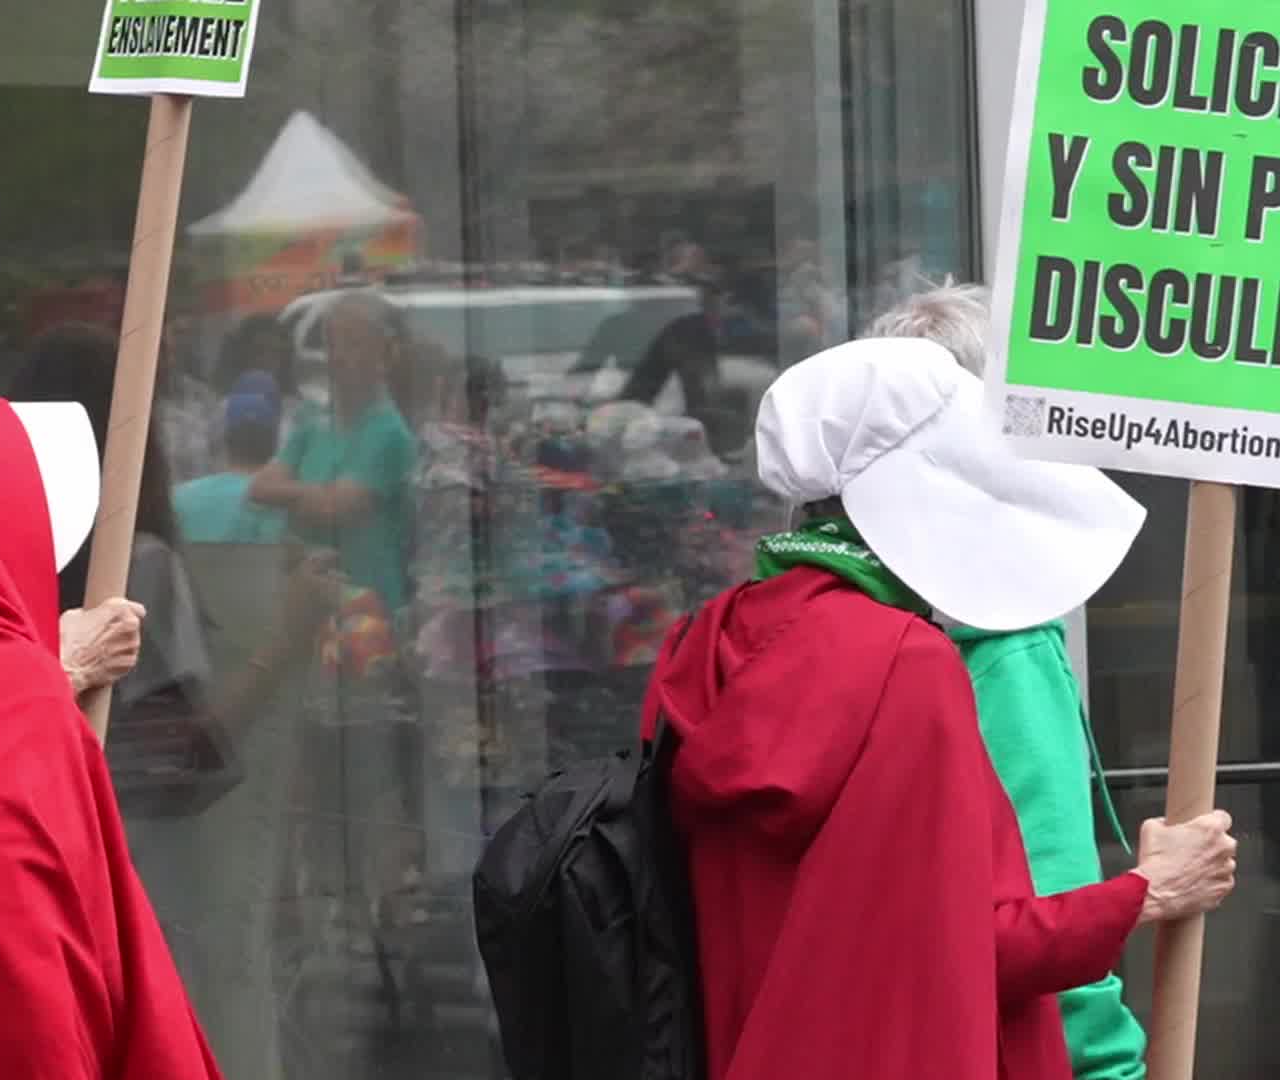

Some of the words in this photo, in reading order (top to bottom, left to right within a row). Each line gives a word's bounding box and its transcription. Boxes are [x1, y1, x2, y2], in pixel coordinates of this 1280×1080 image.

[107, 16, 245, 58] ENSLAVEMENT
[1048, 133, 1088, 220] Y
[1107, 142, 1224, 237] SIN
